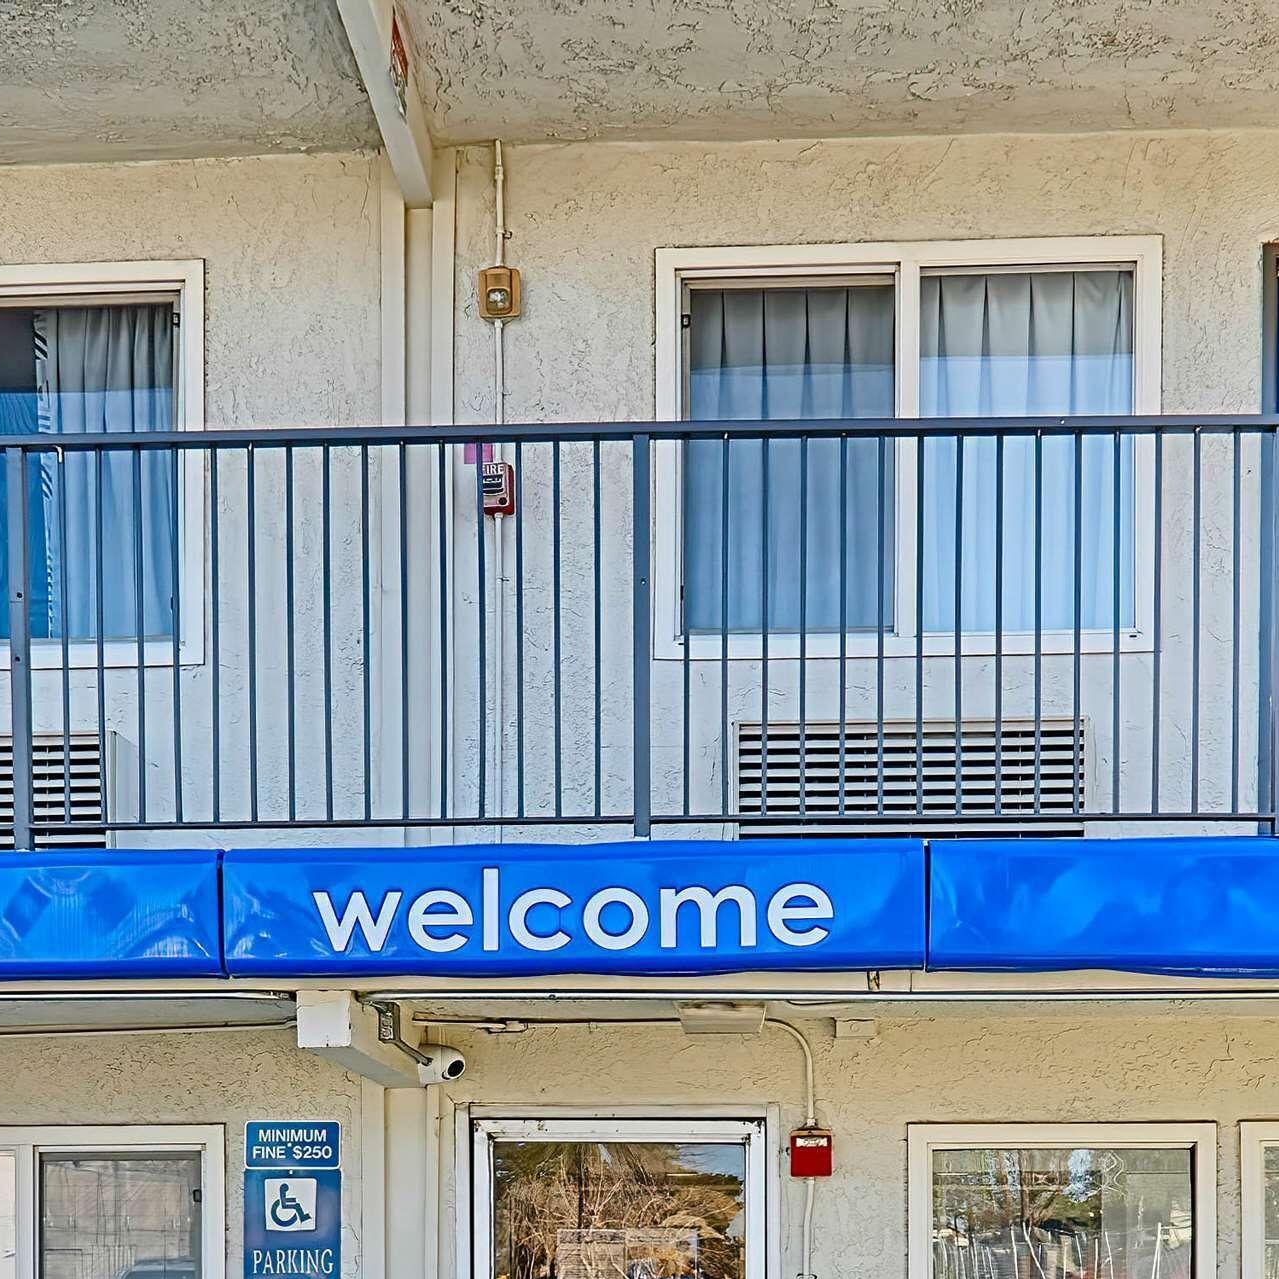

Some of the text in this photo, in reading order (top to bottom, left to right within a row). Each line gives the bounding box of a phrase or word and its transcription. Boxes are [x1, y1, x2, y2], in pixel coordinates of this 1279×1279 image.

[483, 465, 504, 475] IRE
[313, 867, 835, 953] welcome
[258, 1129, 327, 1142] MINIMUM
[252, 1145, 333, 1160] FINE $250
[252, 1248, 334, 1274] PARKING
